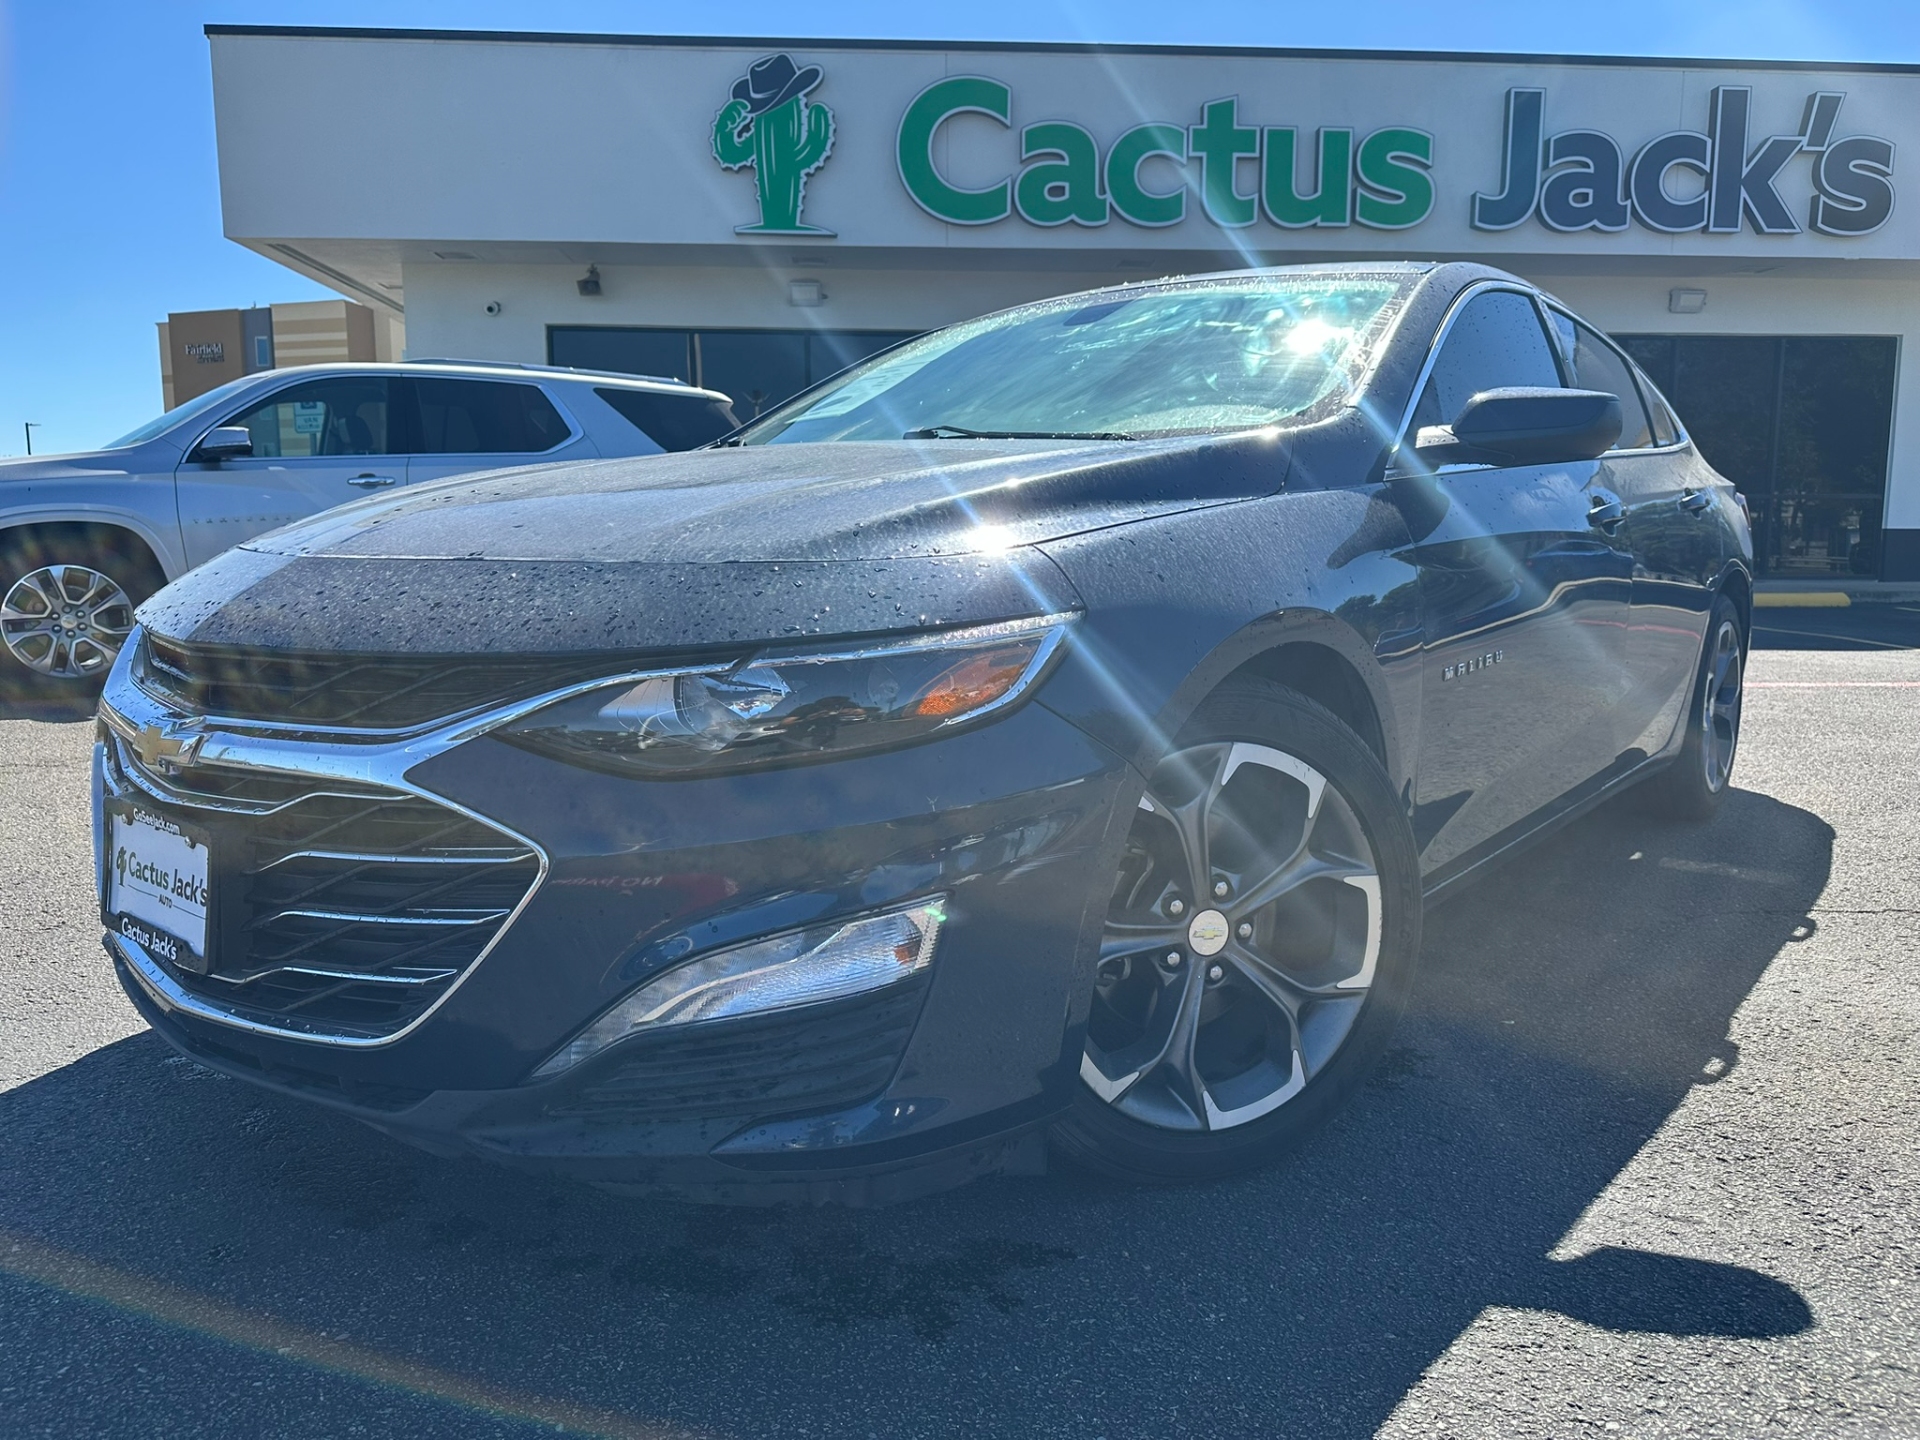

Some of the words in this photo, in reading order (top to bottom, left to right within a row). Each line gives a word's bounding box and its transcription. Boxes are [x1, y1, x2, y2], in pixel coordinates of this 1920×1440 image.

[895, 74, 1436, 229] Cactus
[1470, 85, 1897, 237] Jack's
[185, 343, 222, 355] Fairfield
[1443, 650, 1503, 681] MALIBU
[128, 851, 169, 891] Cactus
[171, 868, 208, 907] Jack's
[158, 894, 173, 909] AUTO
[122, 917, 150, 947] Cactus
[151, 931, 177, 960] Jack's
